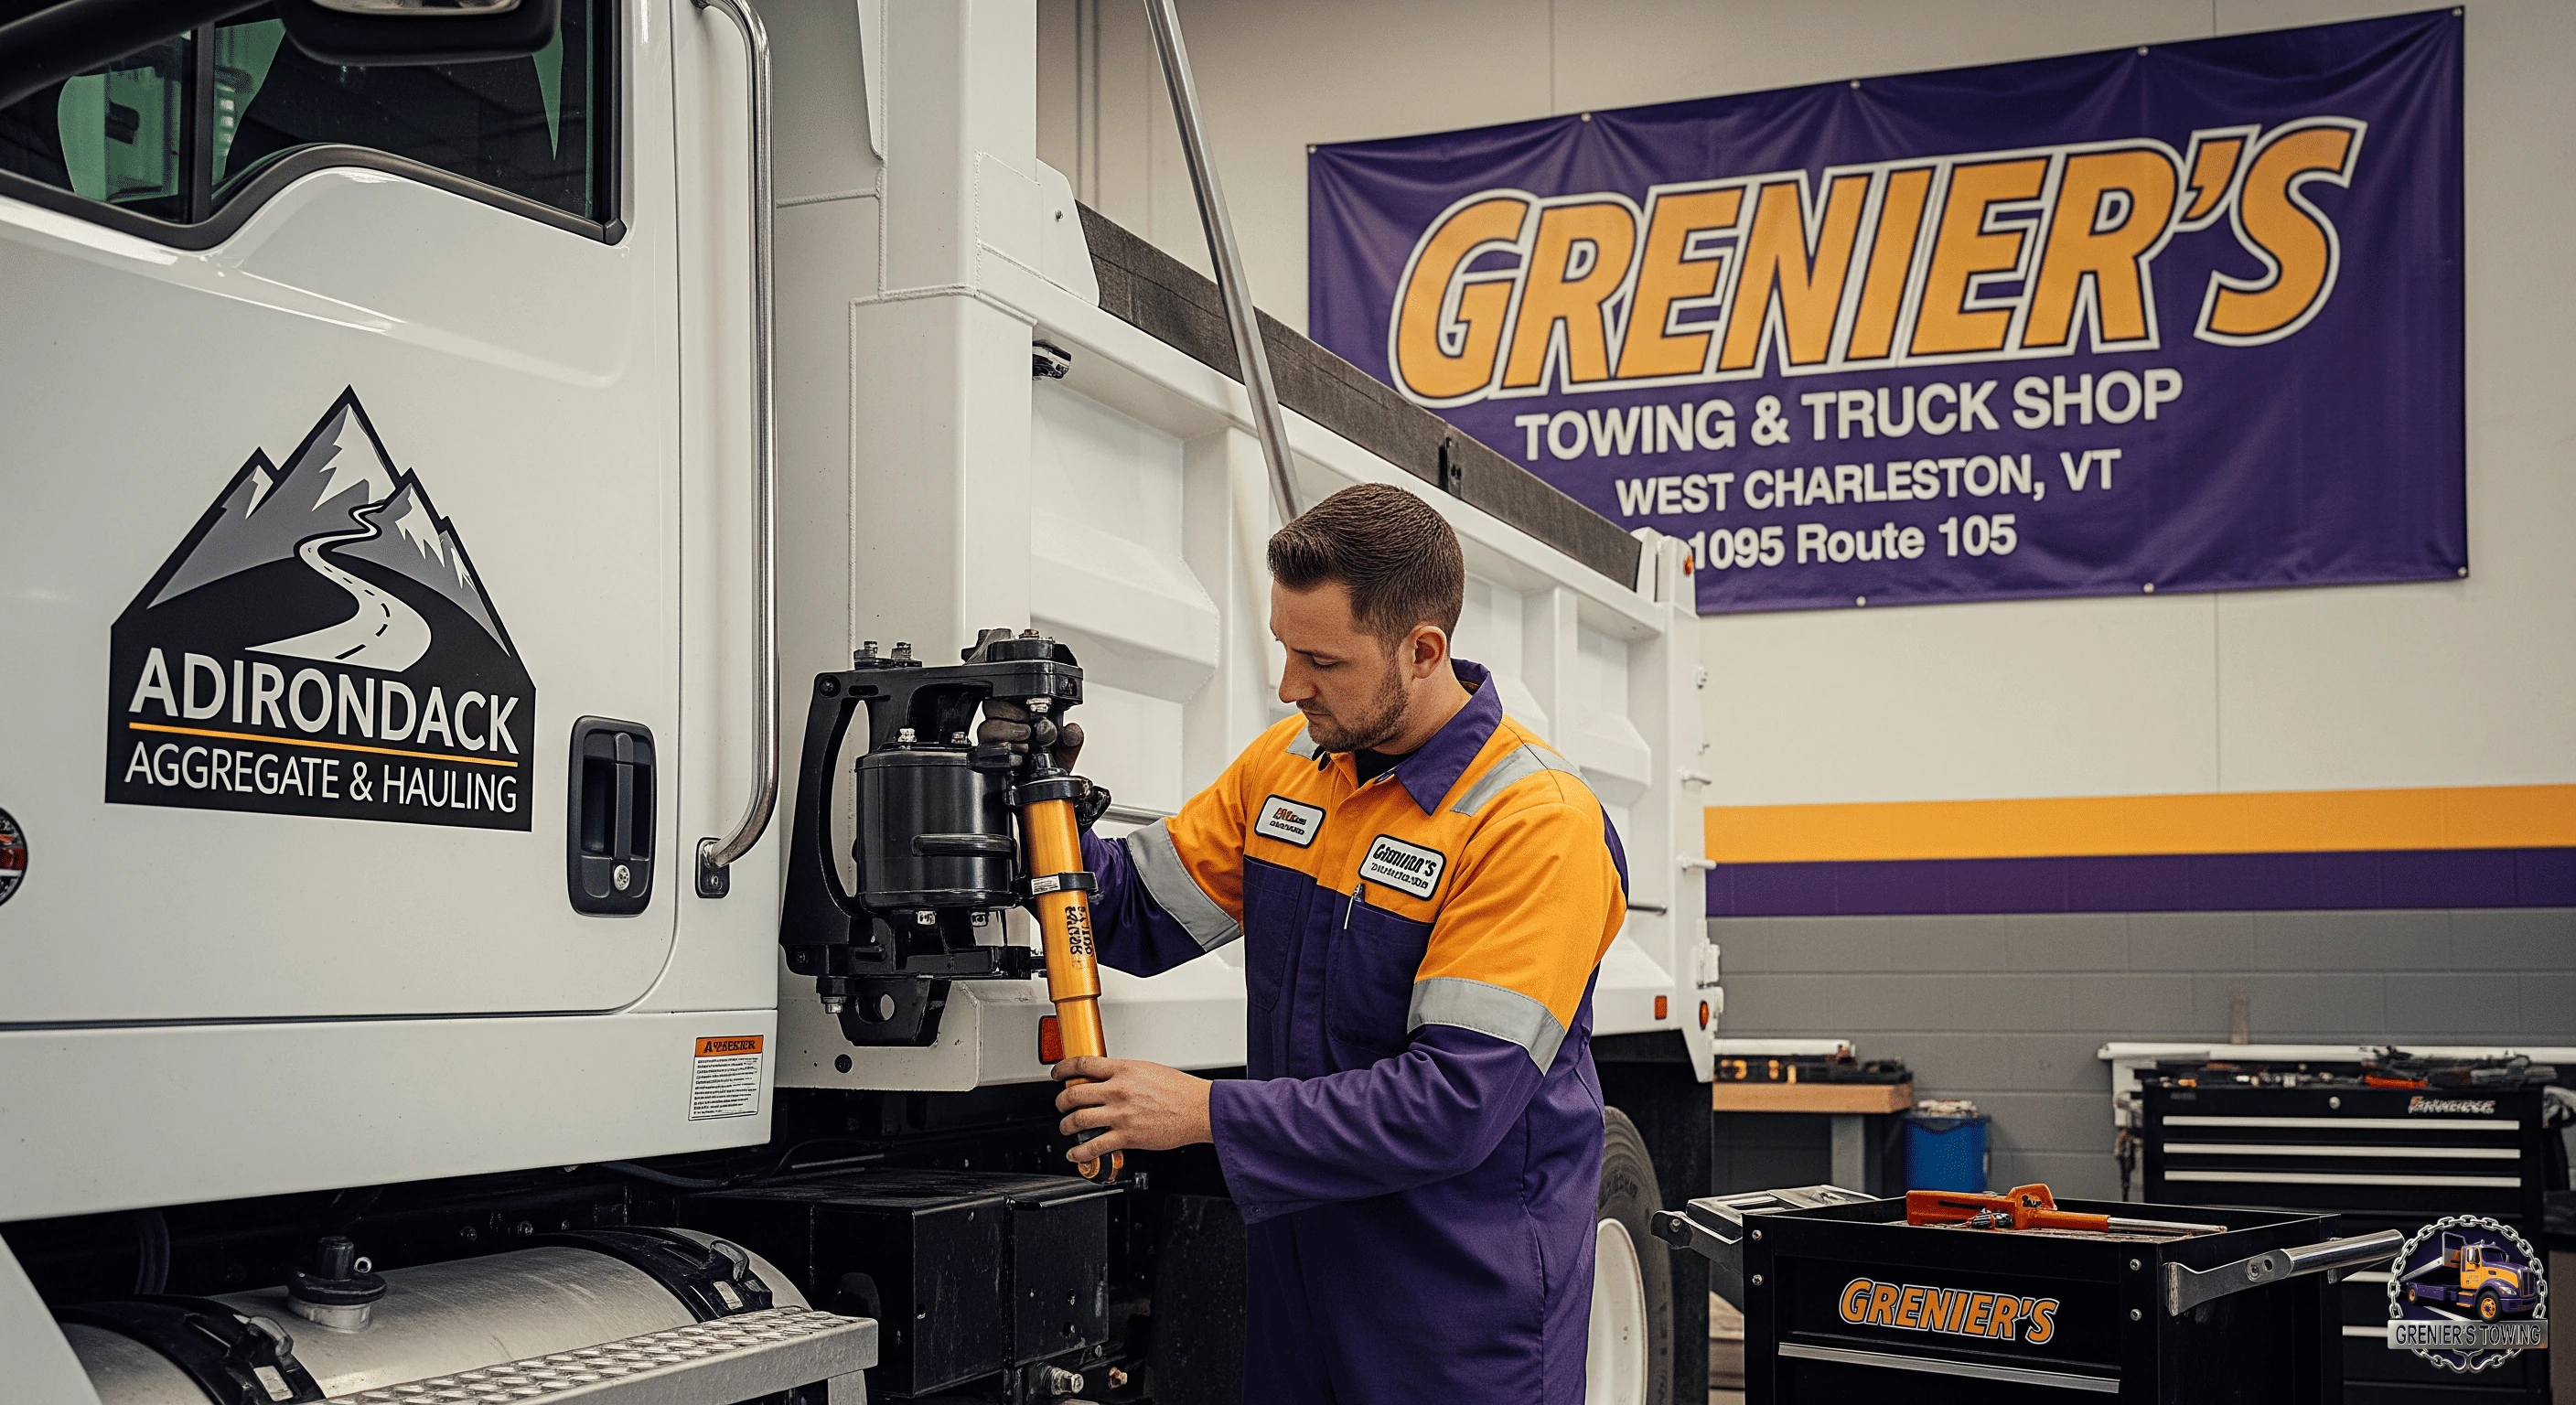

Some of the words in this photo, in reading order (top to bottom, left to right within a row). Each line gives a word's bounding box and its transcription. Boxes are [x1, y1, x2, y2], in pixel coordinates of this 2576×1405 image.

[1388, 117, 2367, 409] GRENIER'S
[1515, 401, 1736, 461] TOWING
[1751, 395, 1792, 446] &
[1801, 380, 2000, 441] TRUCK
[2012, 368, 2184, 428] SHOP
[1615, 472, 1734, 517] WEST
[1744, 454, 2045, 510] CHARLESTON,
[2060, 449, 2121, 490] VT
[1689, 525, 1786, 570] 1095
[1797, 522, 1926, 564] Route
[1937, 514, 2018, 557] 105
[129, 647, 519, 755] ADIRONDACK
[124, 742, 339, 799] AGGREGATE
[349, 761, 373, 801] &
[382, 765, 517, 812] HAULING
[1839, 1277, 2060, 1345] GRENIER'S
